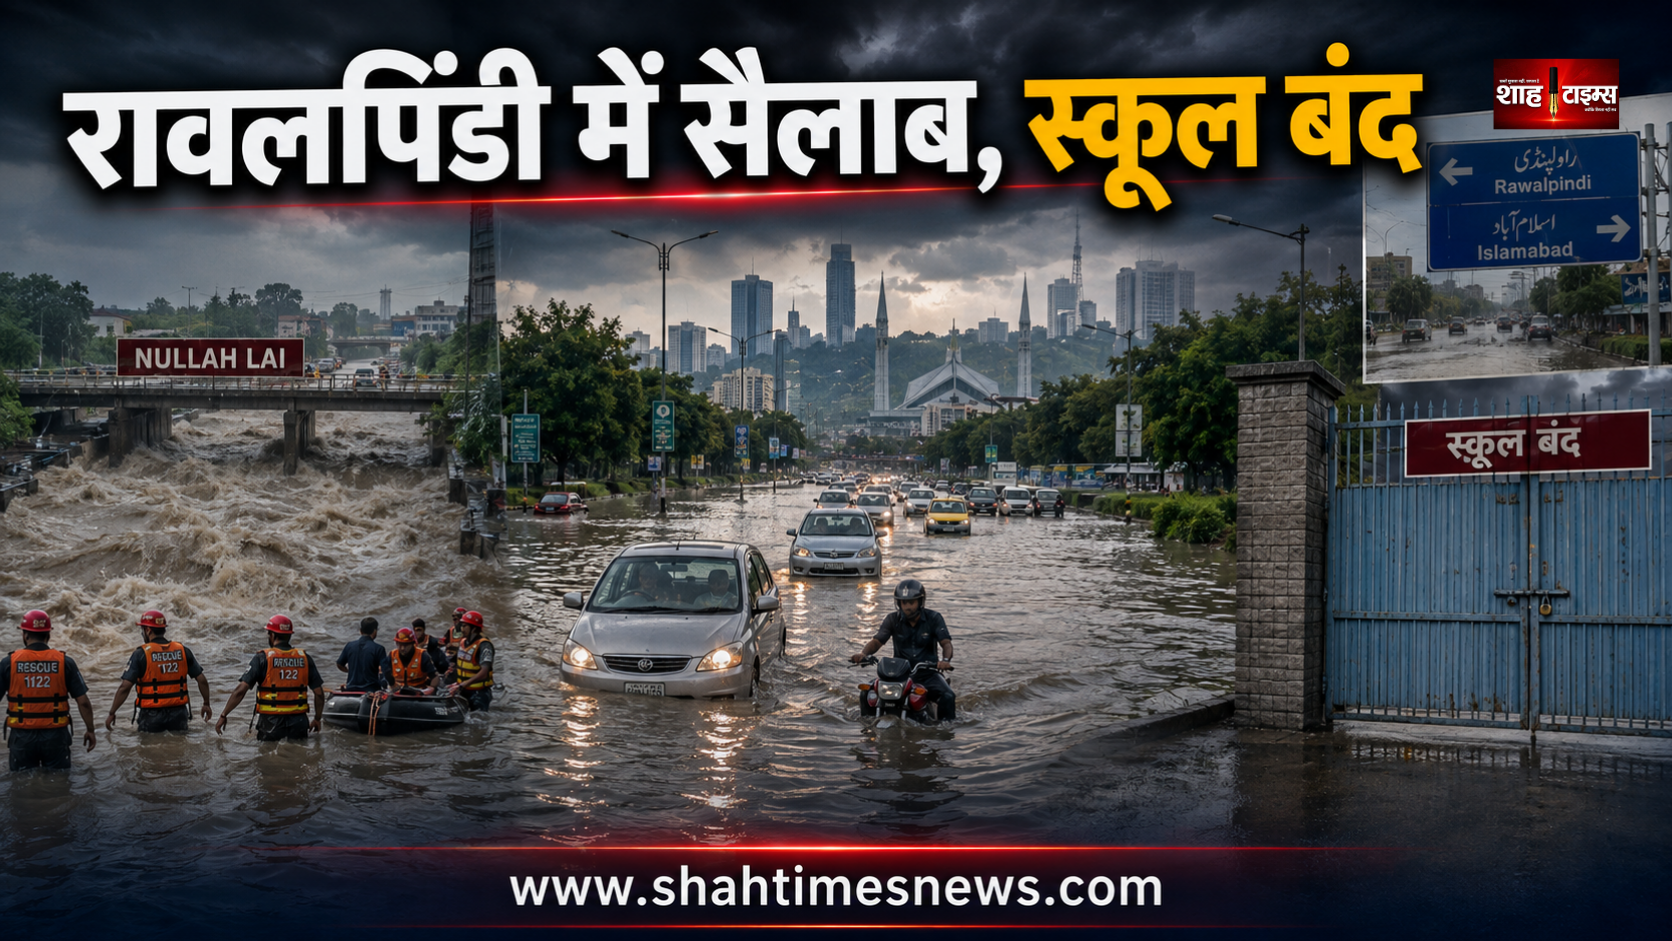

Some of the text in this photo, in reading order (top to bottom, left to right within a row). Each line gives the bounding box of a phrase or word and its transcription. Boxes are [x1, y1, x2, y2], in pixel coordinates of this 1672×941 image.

[1494, 175, 1592, 195] Rawalpindi
[1478, 241, 1573, 261] Islamabad
[135, 347, 285, 369] NULLAH LAI
[1445, 419, 1582, 469] स्कूल बंद
[17, 662, 58, 673] RESCUE
[23, 675, 51, 688] 1122
